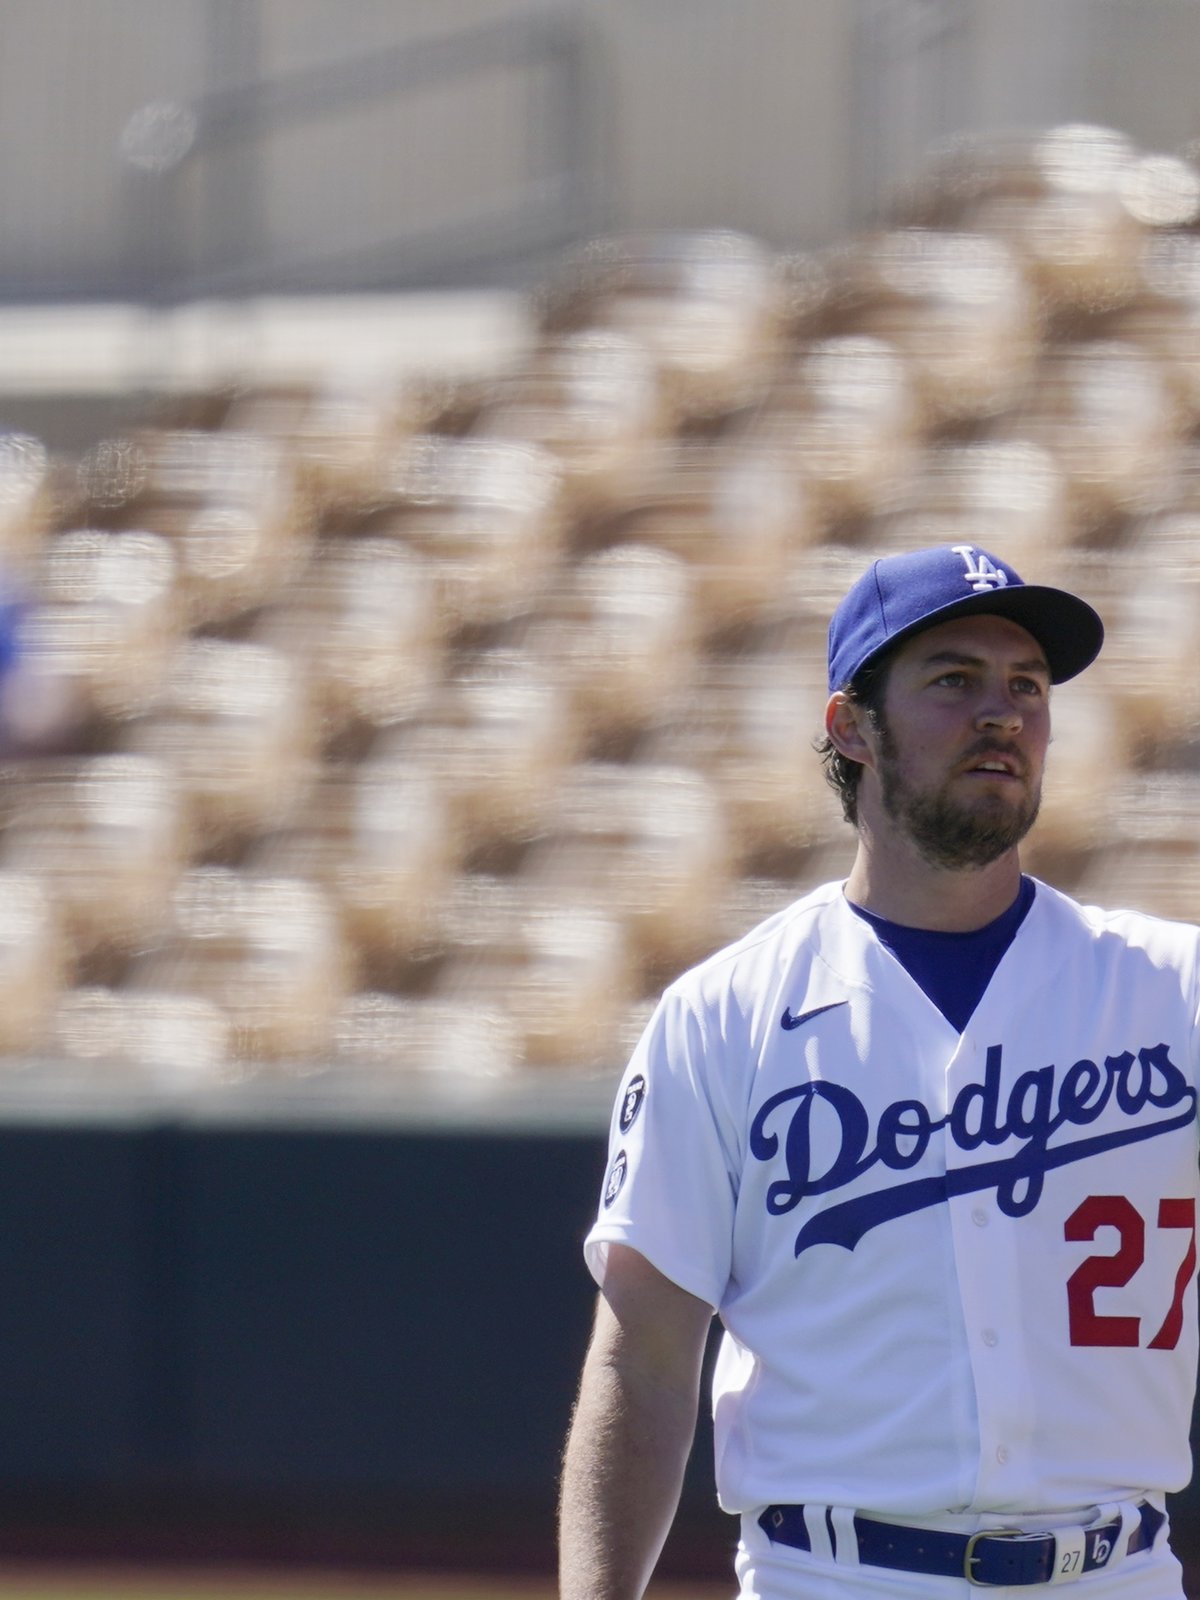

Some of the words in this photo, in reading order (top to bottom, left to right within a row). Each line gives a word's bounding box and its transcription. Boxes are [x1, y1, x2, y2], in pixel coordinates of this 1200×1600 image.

[952, 545, 1008, 592] LA
[750, 1043, 1198, 1219] Dodgers
[1064, 1195, 1196, 1351] 27
[1061, 1551, 1080, 1573] 27
